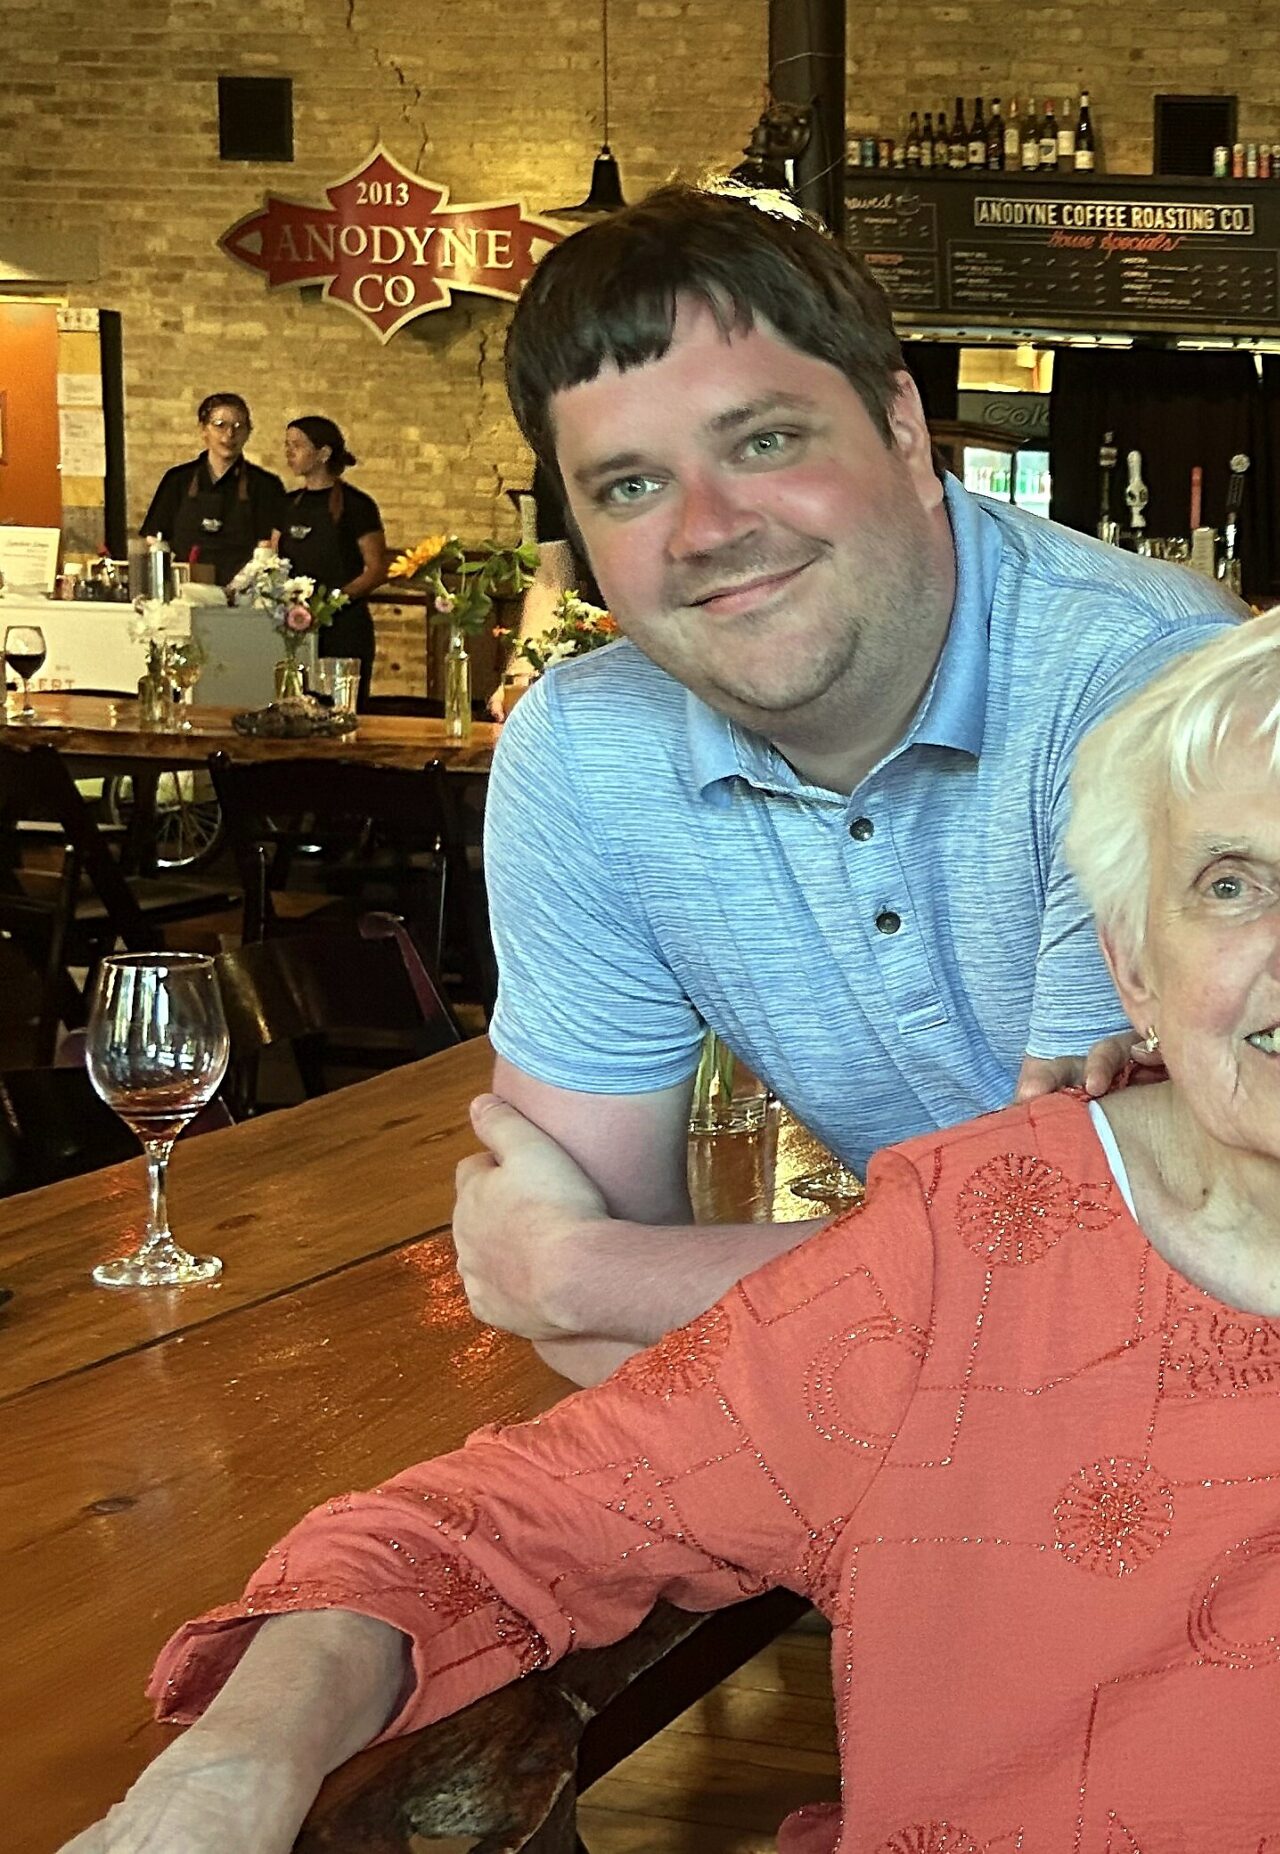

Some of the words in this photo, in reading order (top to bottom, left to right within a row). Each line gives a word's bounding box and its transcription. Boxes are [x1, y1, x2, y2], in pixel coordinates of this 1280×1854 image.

[356, 182, 410, 206] 2013
[980, 201, 1058, 225] ANODYNE
[1062, 204, 1127, 227] COFFEE
[1131, 206, 1215, 230] ROASTING
[1220, 209, 1250, 231] CO.
[277, 224, 513, 269] ANODYNE
[353, 275, 415, 313] CO
